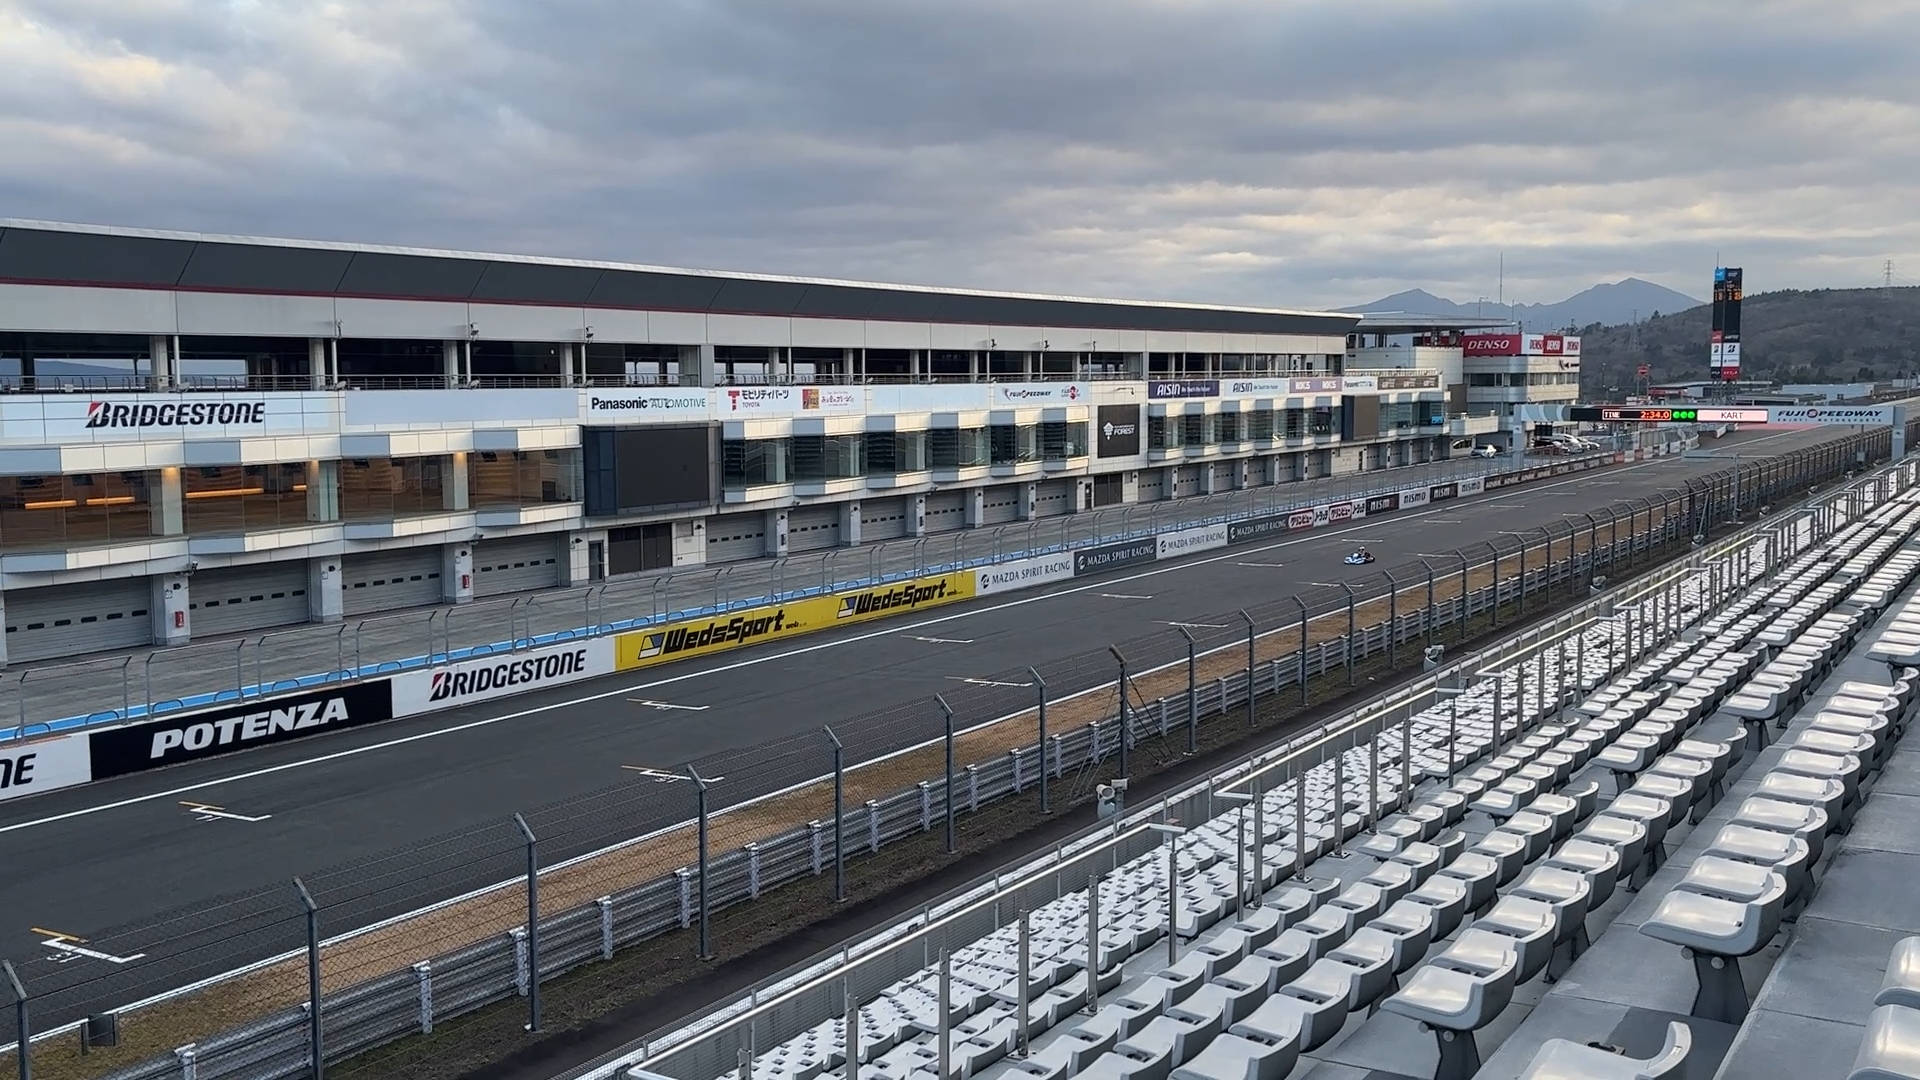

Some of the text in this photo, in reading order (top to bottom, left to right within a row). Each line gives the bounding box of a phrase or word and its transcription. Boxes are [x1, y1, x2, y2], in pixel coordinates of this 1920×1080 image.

[1467, 339, 1510, 350] DENSO
[1157, 383, 1181, 396] AISIN
[1232, 382, 1253, 393] AISIN
[591, 396, 706, 410] Panasonic AUTOMOTIVE
[85, 401, 266, 428] BRIDGESTONE
[1640, 411, 1670, 419] 2:34.0
[1720, 411, 1743, 419] KART
[1807, 408, 1882, 418] SPEEDWAY
[1113, 427, 1135, 436] FOREST
[1236, 525, 1254, 536] MAZDA
[1168, 531, 1225, 550] MAZDA SPIRIT RACING
[1087, 544, 1154, 566] MAZDA SPIRIT RACING
[992, 560, 1070, 584] MAZDA SPIRIT RACING
[854, 579, 947, 615] WedsSport
[663, 610, 785, 653] WedsSport
[428, 649, 588, 702] BRIDGESTONE
[150, 698, 349, 759] POTENZA
